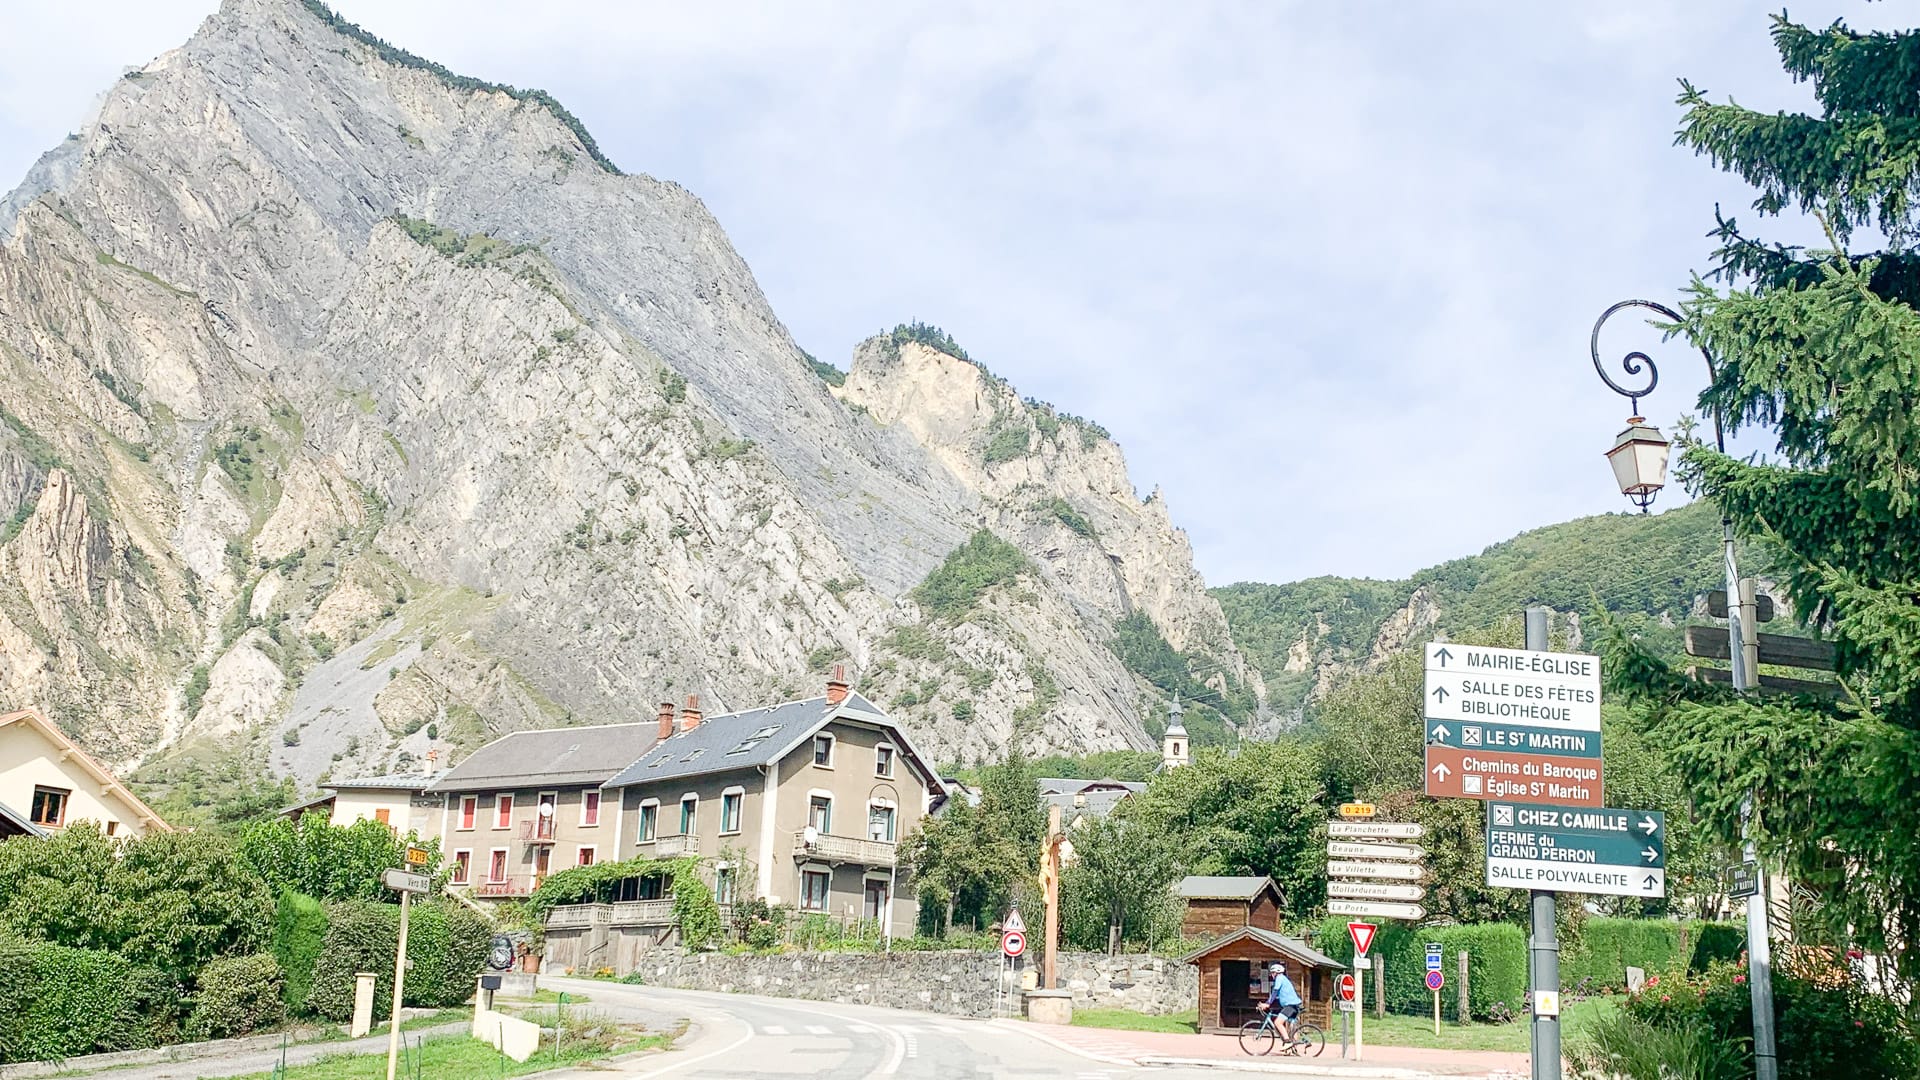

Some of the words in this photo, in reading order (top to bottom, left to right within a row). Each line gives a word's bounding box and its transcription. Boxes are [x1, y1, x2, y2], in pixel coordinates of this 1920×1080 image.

[1467, 652, 1591, 677] MAIRIE-ÉGLISE
[1462, 680, 1509, 697] SALLE
[1514, 685, 1544, 699] DES
[1548, 685, 1594, 703] FÊTES
[1462, 701, 1571, 721] BIBLIOTHÈQUE
[1486, 730, 1505, 745] LE
[1529, 733, 1586, 751] MARTIN
[1462, 757, 1520, 774] Chemins
[1523, 762, 1540, 776] du
[1543, 763, 1597, 782] Baroque
[1487, 776, 1527, 797] Église
[1549, 783, 1589, 800] Martin
[1332, 825, 1341, 833] La
[1345, 825, 1389, 834] Planchette
[1518, 810, 1558, 827] CHEZ
[1562, 815, 1628, 832] CAMILLE
[1332, 844, 1365, 853] Beaune
[1491, 831, 1535, 846] FERME
[1539, 834, 1554, 847] du
[1491, 846, 1538, 859] GRAND
[1542, 848, 1595, 863] PERRON
[1332, 865, 1341, 873] La
[1345, 866, 1376, 874] Villette
[1409, 868, 1415, 876] 5
[1492, 866, 1533, 880] SALLE
[1537, 869, 1628, 886] POLYVALENTE
[1332, 885, 1387, 895] Mollardurand
[1332, 903, 1341, 911] La
[1345, 904, 1369, 913] Porte
